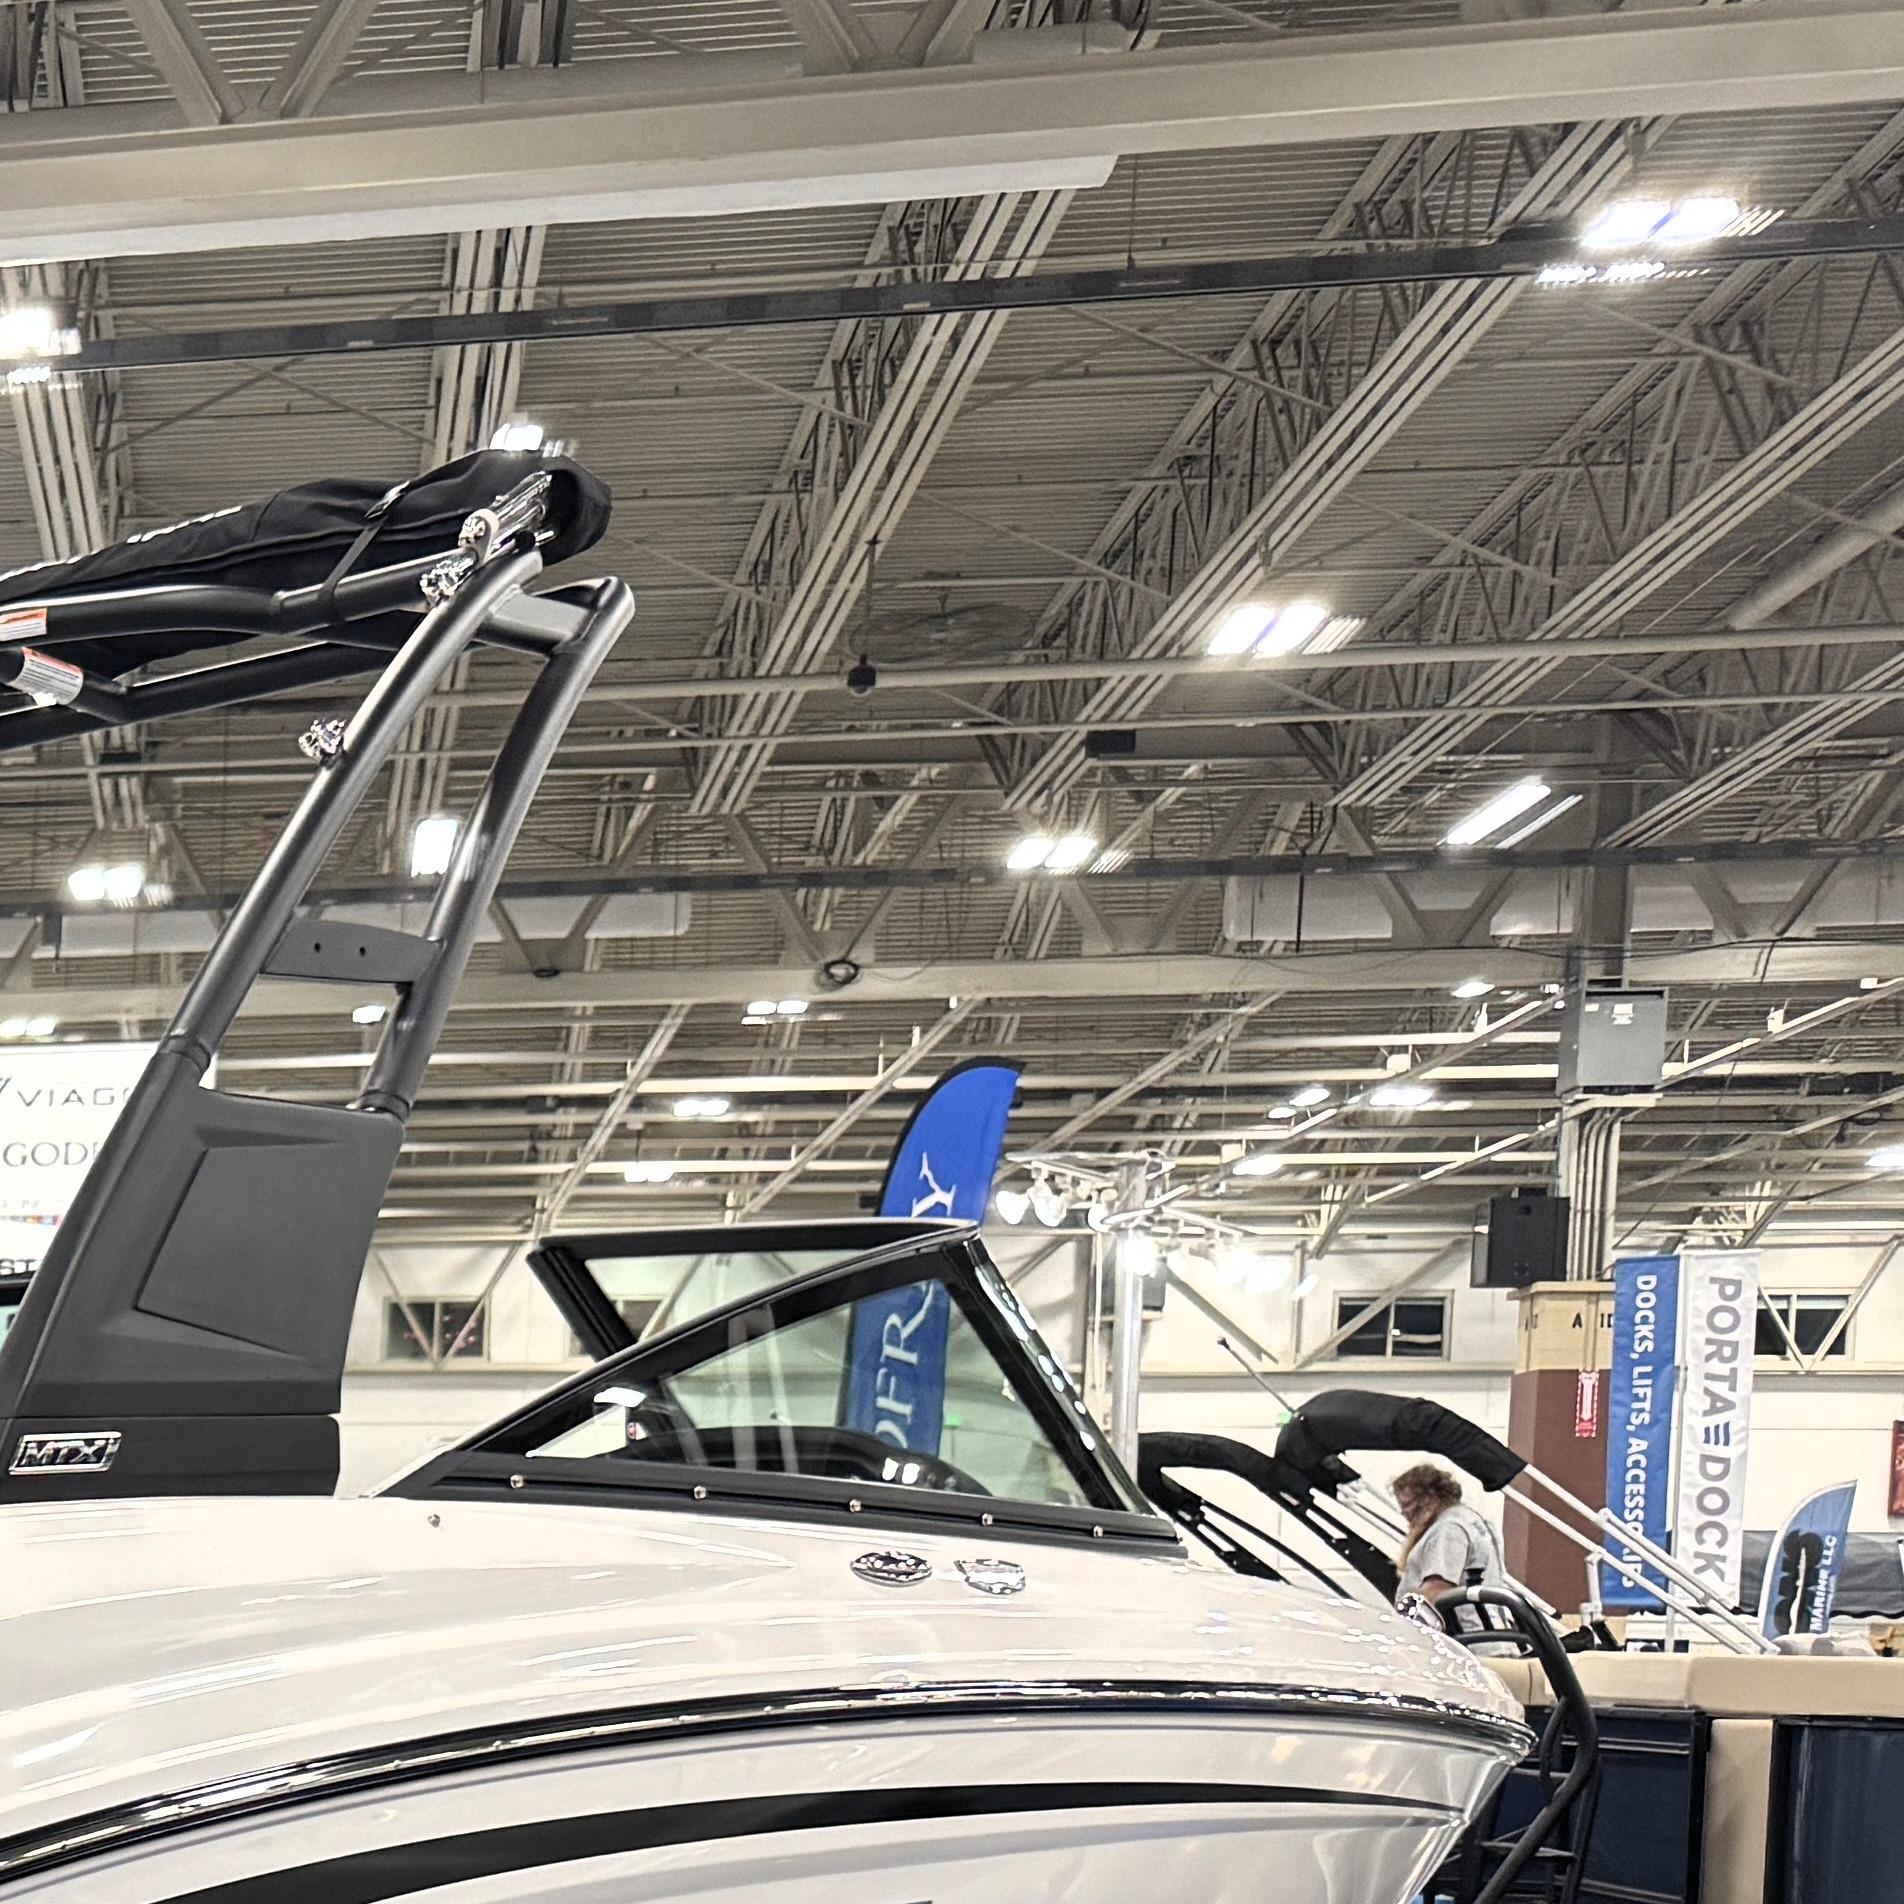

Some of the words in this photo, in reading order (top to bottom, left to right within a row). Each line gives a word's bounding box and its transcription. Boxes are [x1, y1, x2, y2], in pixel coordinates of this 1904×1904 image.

[17, 1087, 130, 1108] VIAG
[1572, 1313, 1583, 1328] A
[1629, 1274, 1657, 1359] DOCKS,
[1626, 1365, 1653, 1430] LIFTS,
[1823, 1535, 1838, 1566] LLC
